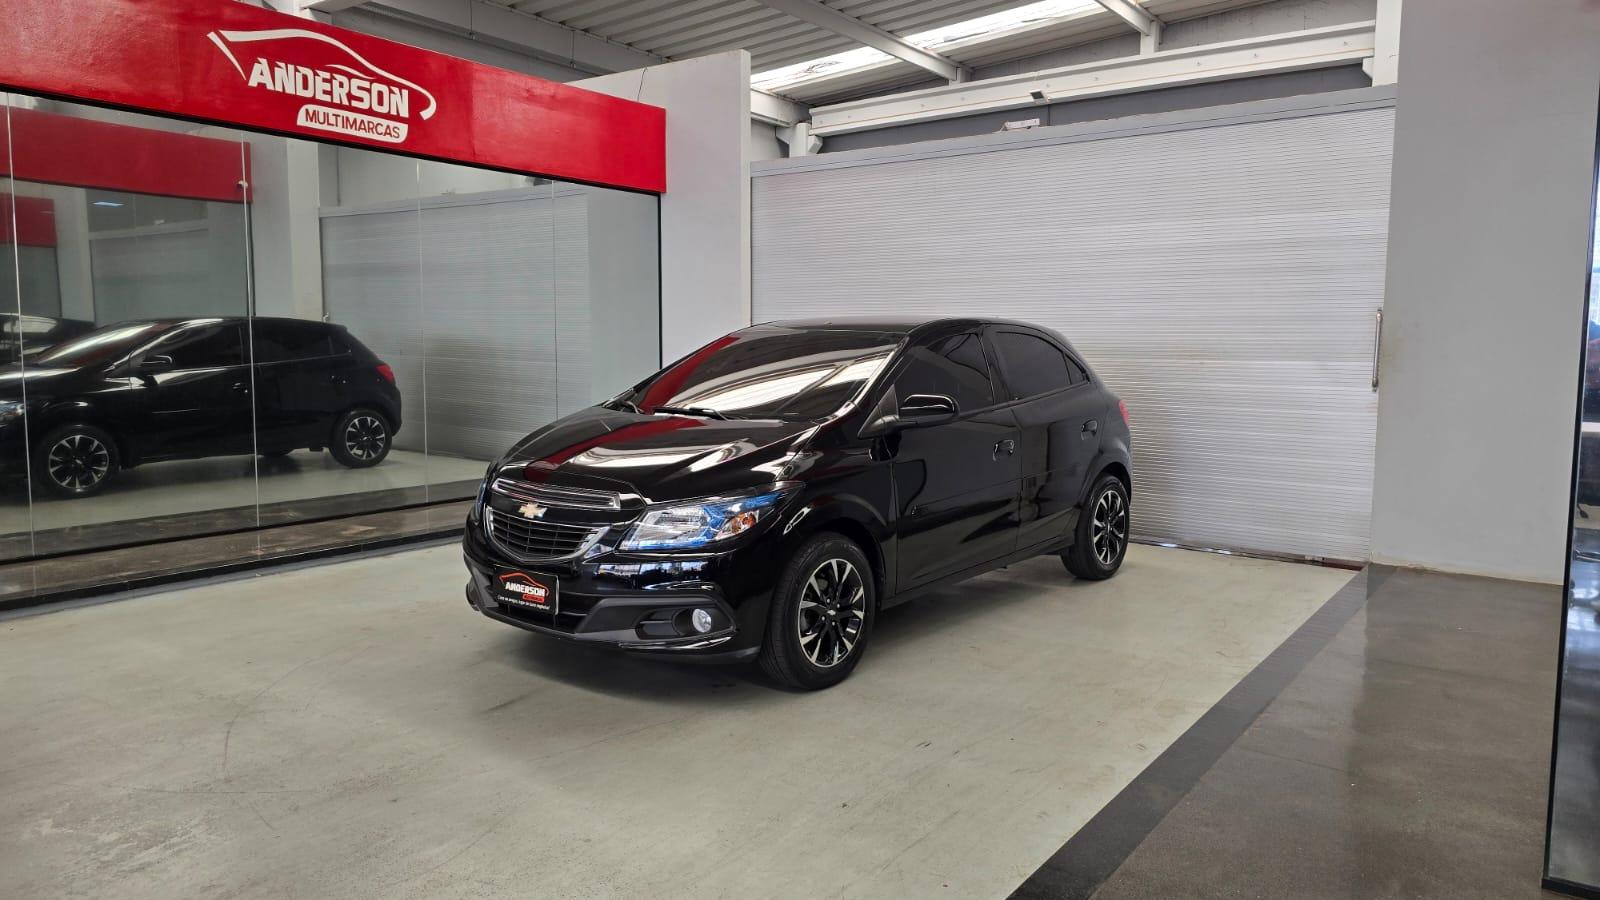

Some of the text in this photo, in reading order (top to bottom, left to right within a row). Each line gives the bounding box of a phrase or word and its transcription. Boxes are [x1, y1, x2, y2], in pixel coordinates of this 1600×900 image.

[248, 57, 409, 118] ANDERSON
[304, 108, 401, 139] MULTIMARCAS
[505, 582, 545, 596] ANDERSON
